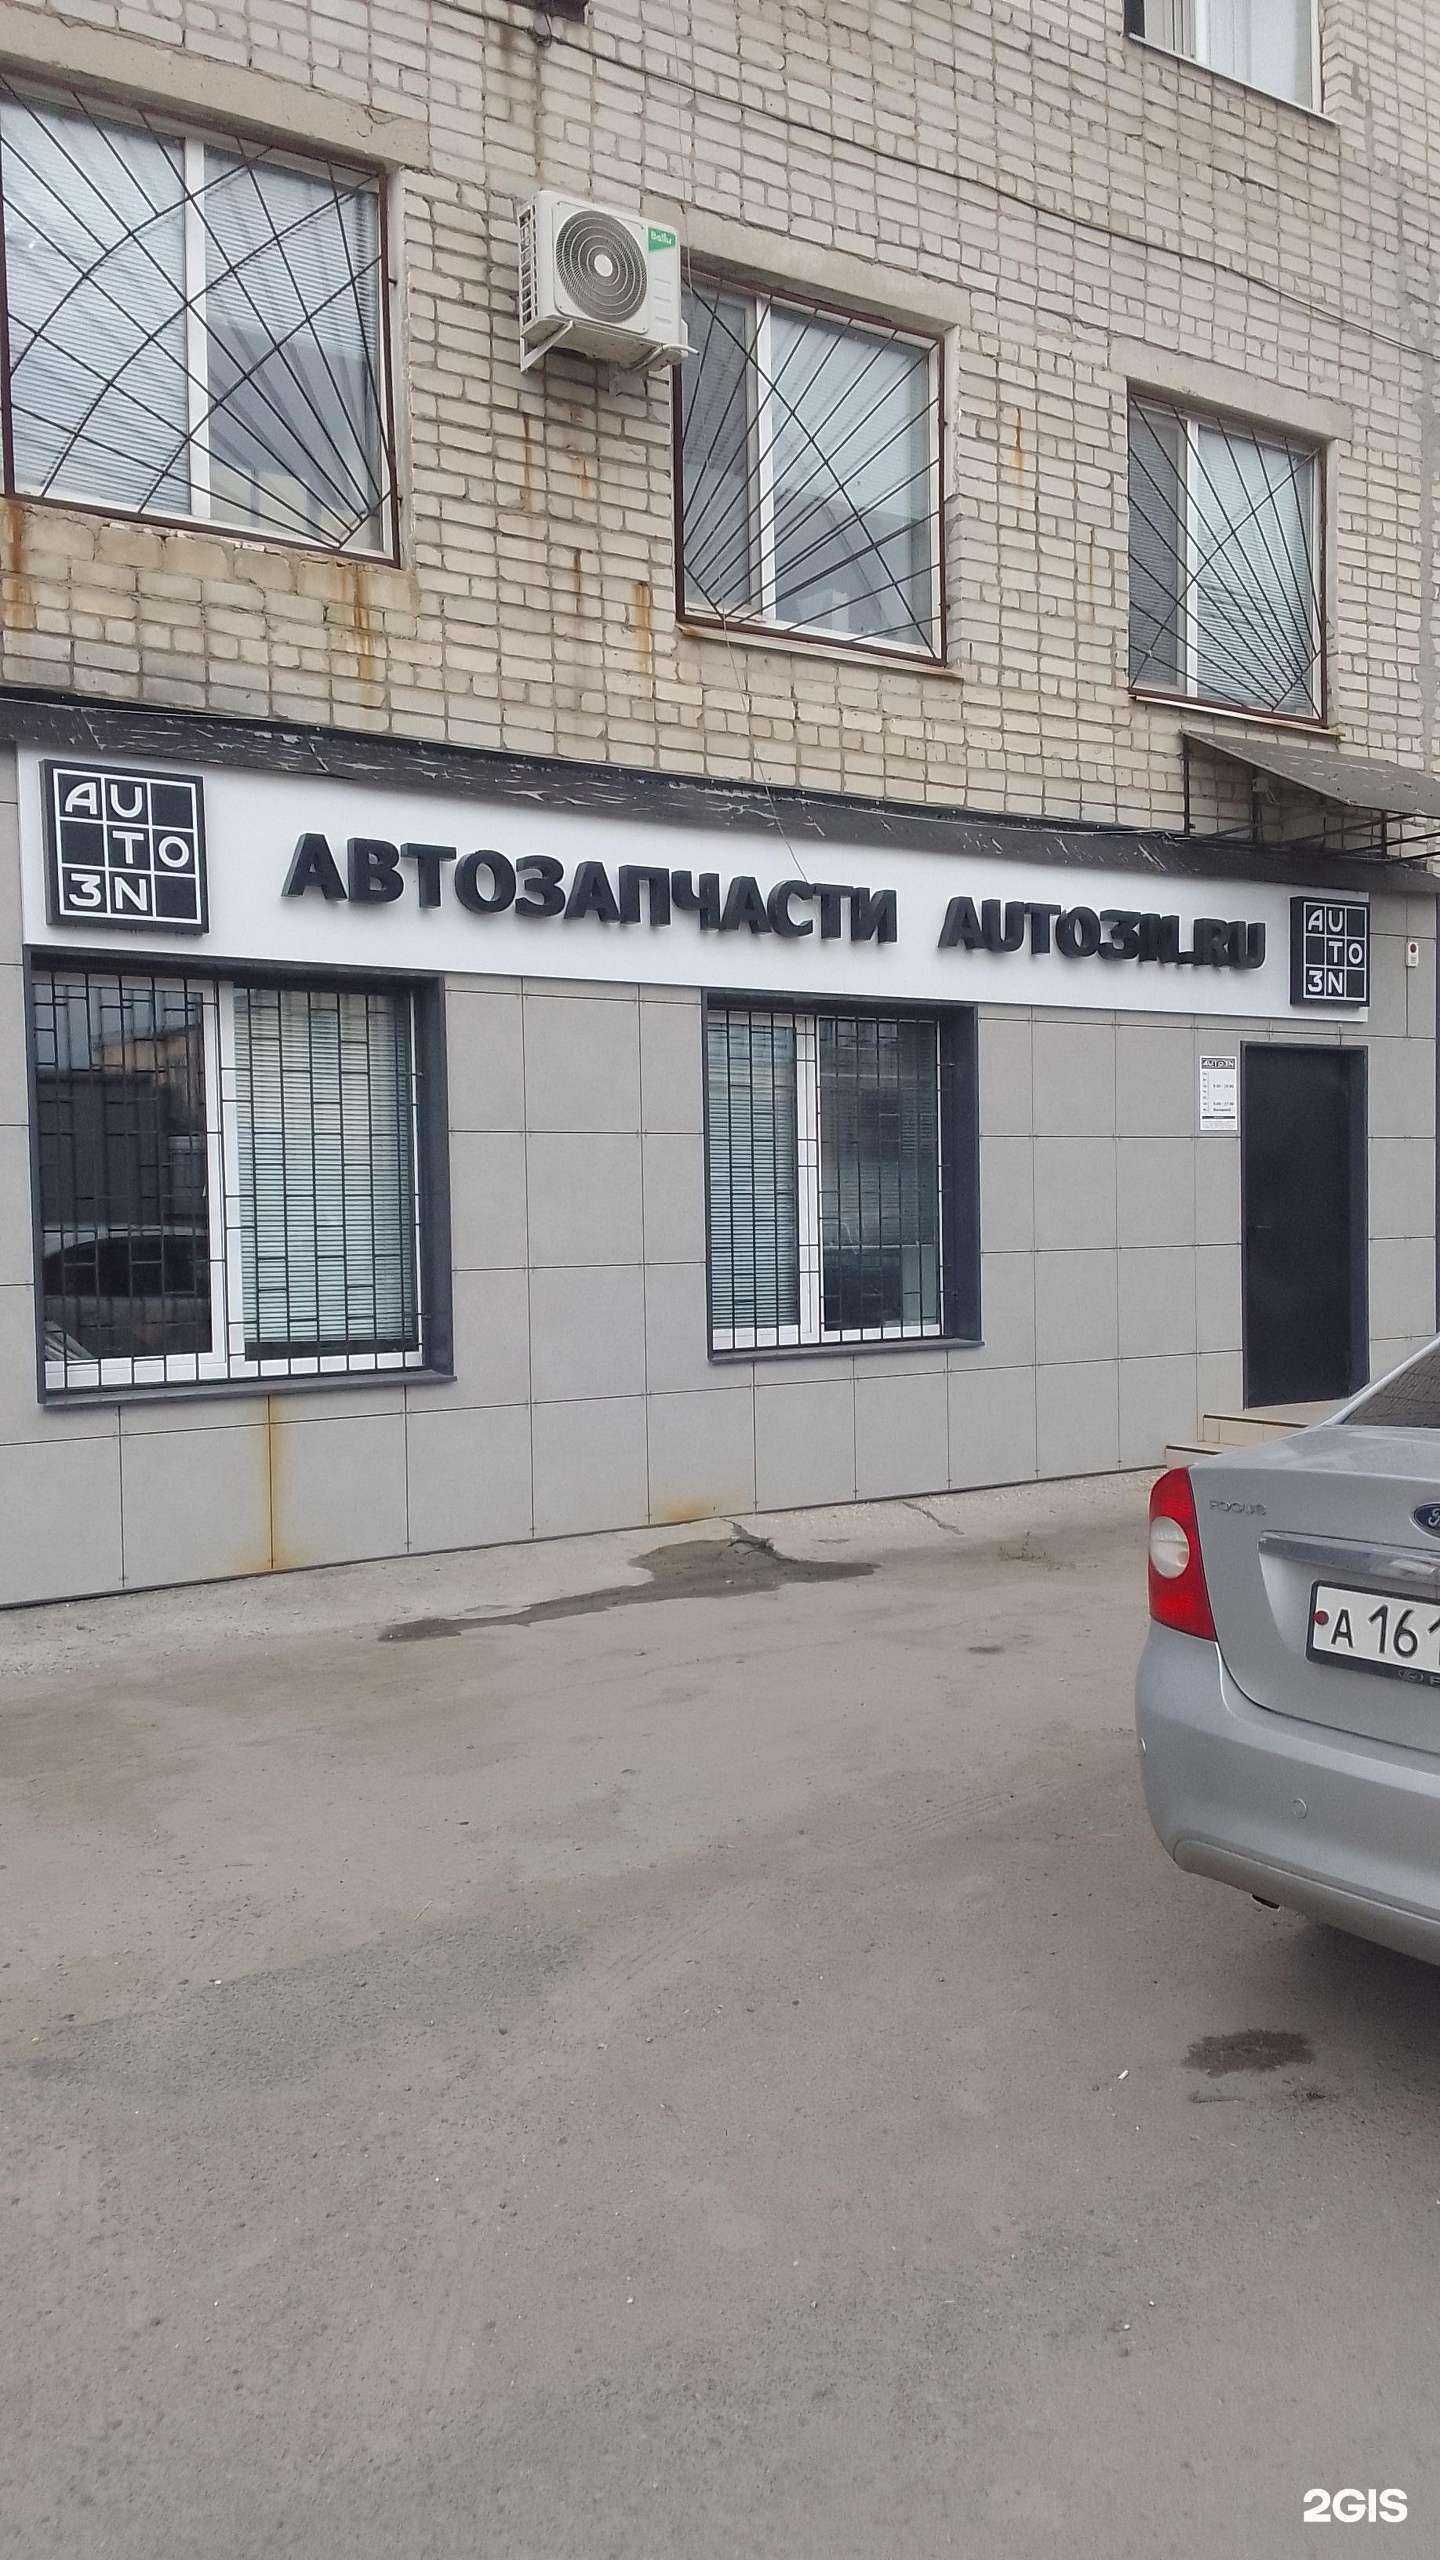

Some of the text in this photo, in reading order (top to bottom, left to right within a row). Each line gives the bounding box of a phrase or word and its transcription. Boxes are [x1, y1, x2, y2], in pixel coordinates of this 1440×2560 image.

[64, 781, 143, 818] AU
[68, 872, 148, 911] 3N
[281, 832, 898, 945] АВТОЗАПЧАСТИ
[1307, 909, 1343, 932] AU
[1307, 970, 1343, 994] 3N
